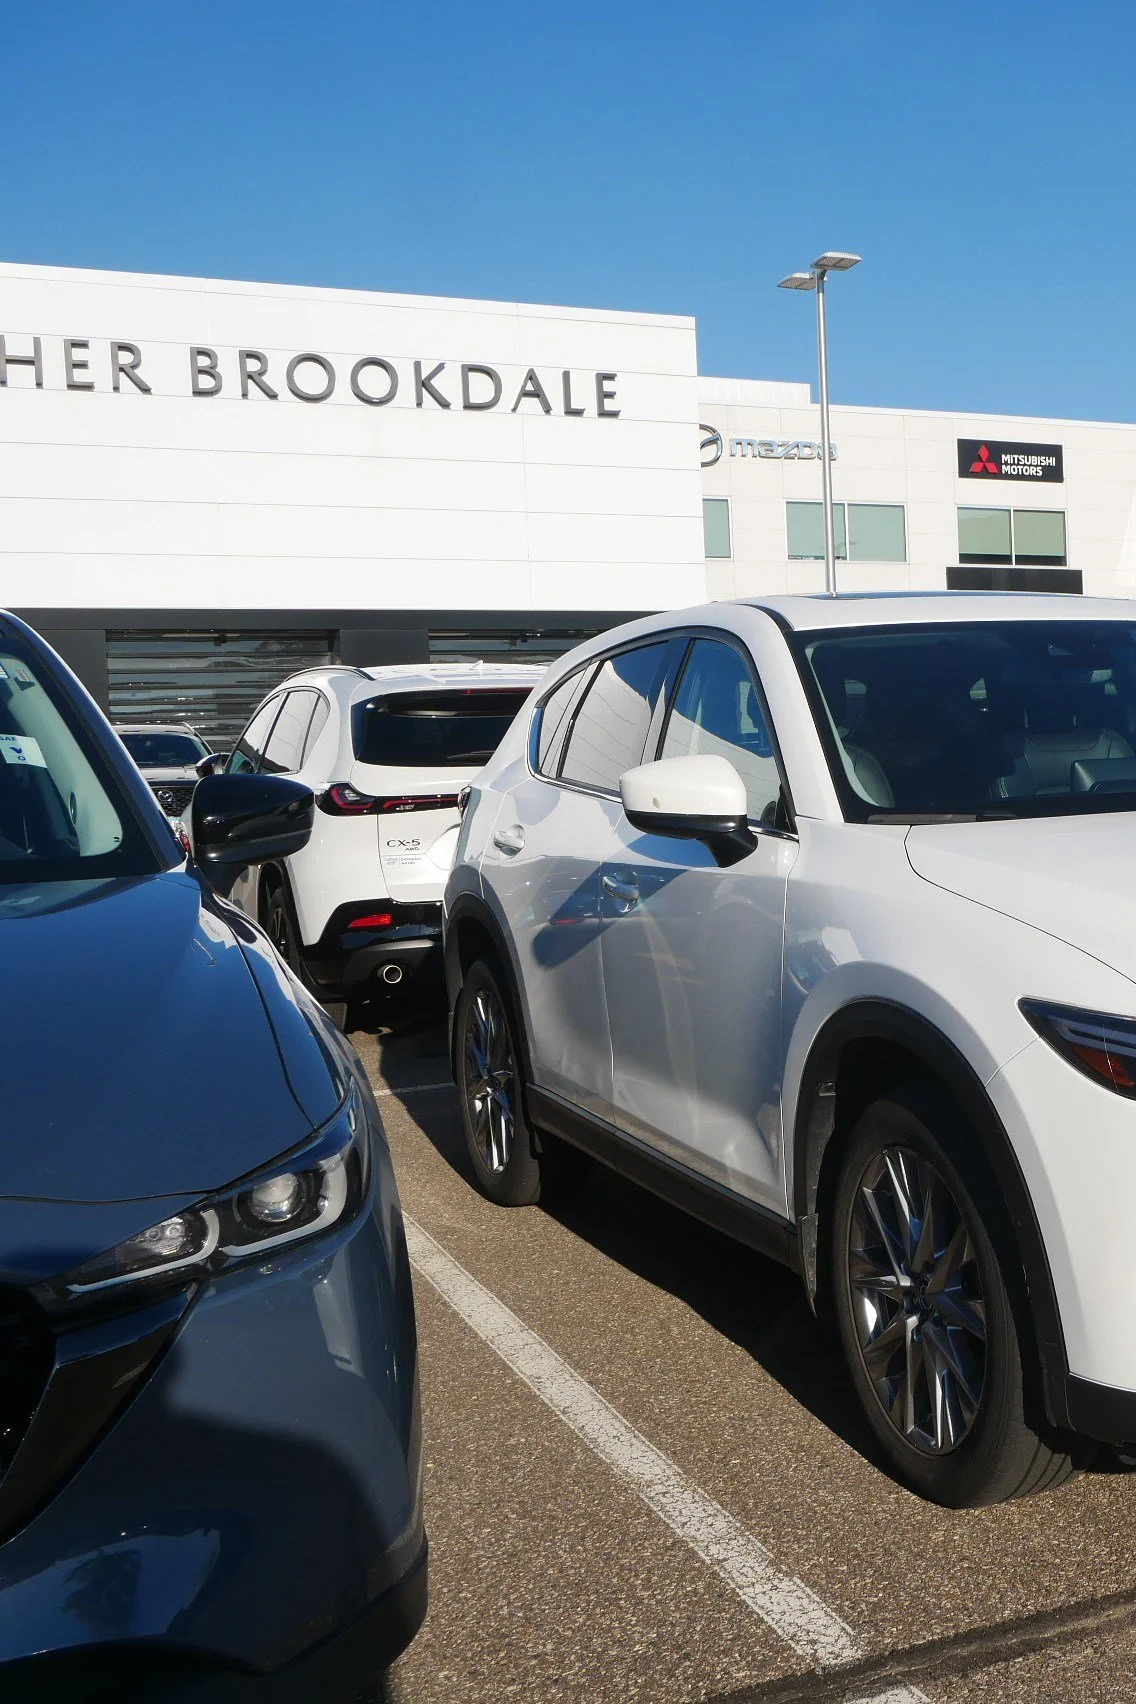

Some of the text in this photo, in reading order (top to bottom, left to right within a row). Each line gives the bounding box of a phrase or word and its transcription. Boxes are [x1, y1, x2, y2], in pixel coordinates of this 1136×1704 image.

[189, 345, 622, 418] BROOKDALE
[1001, 454, 1056, 467] MITSUBISHI
[1001, 465, 1043, 477] MOTORS
[386, 838, 421, 847] CX-5
